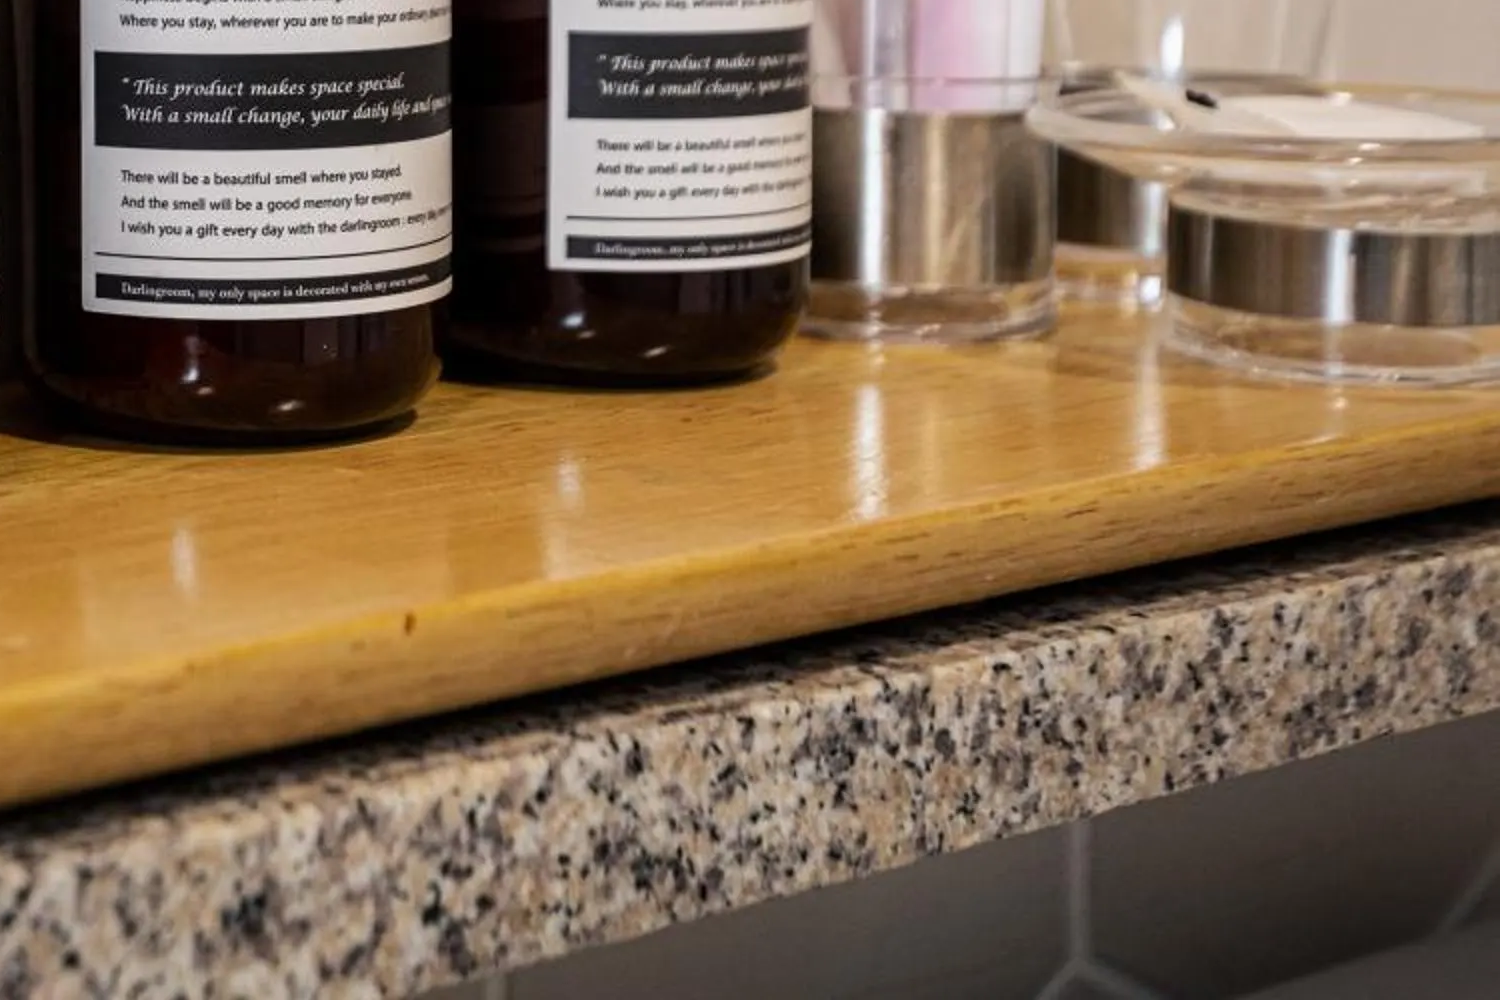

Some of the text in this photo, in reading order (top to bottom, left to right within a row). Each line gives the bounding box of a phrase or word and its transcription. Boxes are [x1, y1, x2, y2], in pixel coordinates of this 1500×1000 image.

[638, 0, 662, 11] you
[119, 12, 397, 31] Where you stay, wherever you are to make your
[611, 54, 756, 75] This product makes
[133, 77, 354, 101] This product makes space
[599, 78, 703, 97] With a small
[122, 101, 390, 129] With a small change, your daily
[596, 138, 631, 152] There
[121, 169, 369, 186] There will be a beautiful smell where you
[596, 162, 644, 175] And the
[602, 186, 656, 201] wish you
[121, 193, 370, 214] And the smell will be a good memory for
[121, 216, 401, 240] I wish you a gift every day with the darlingroom
[248, 282, 349, 302] space decorated
